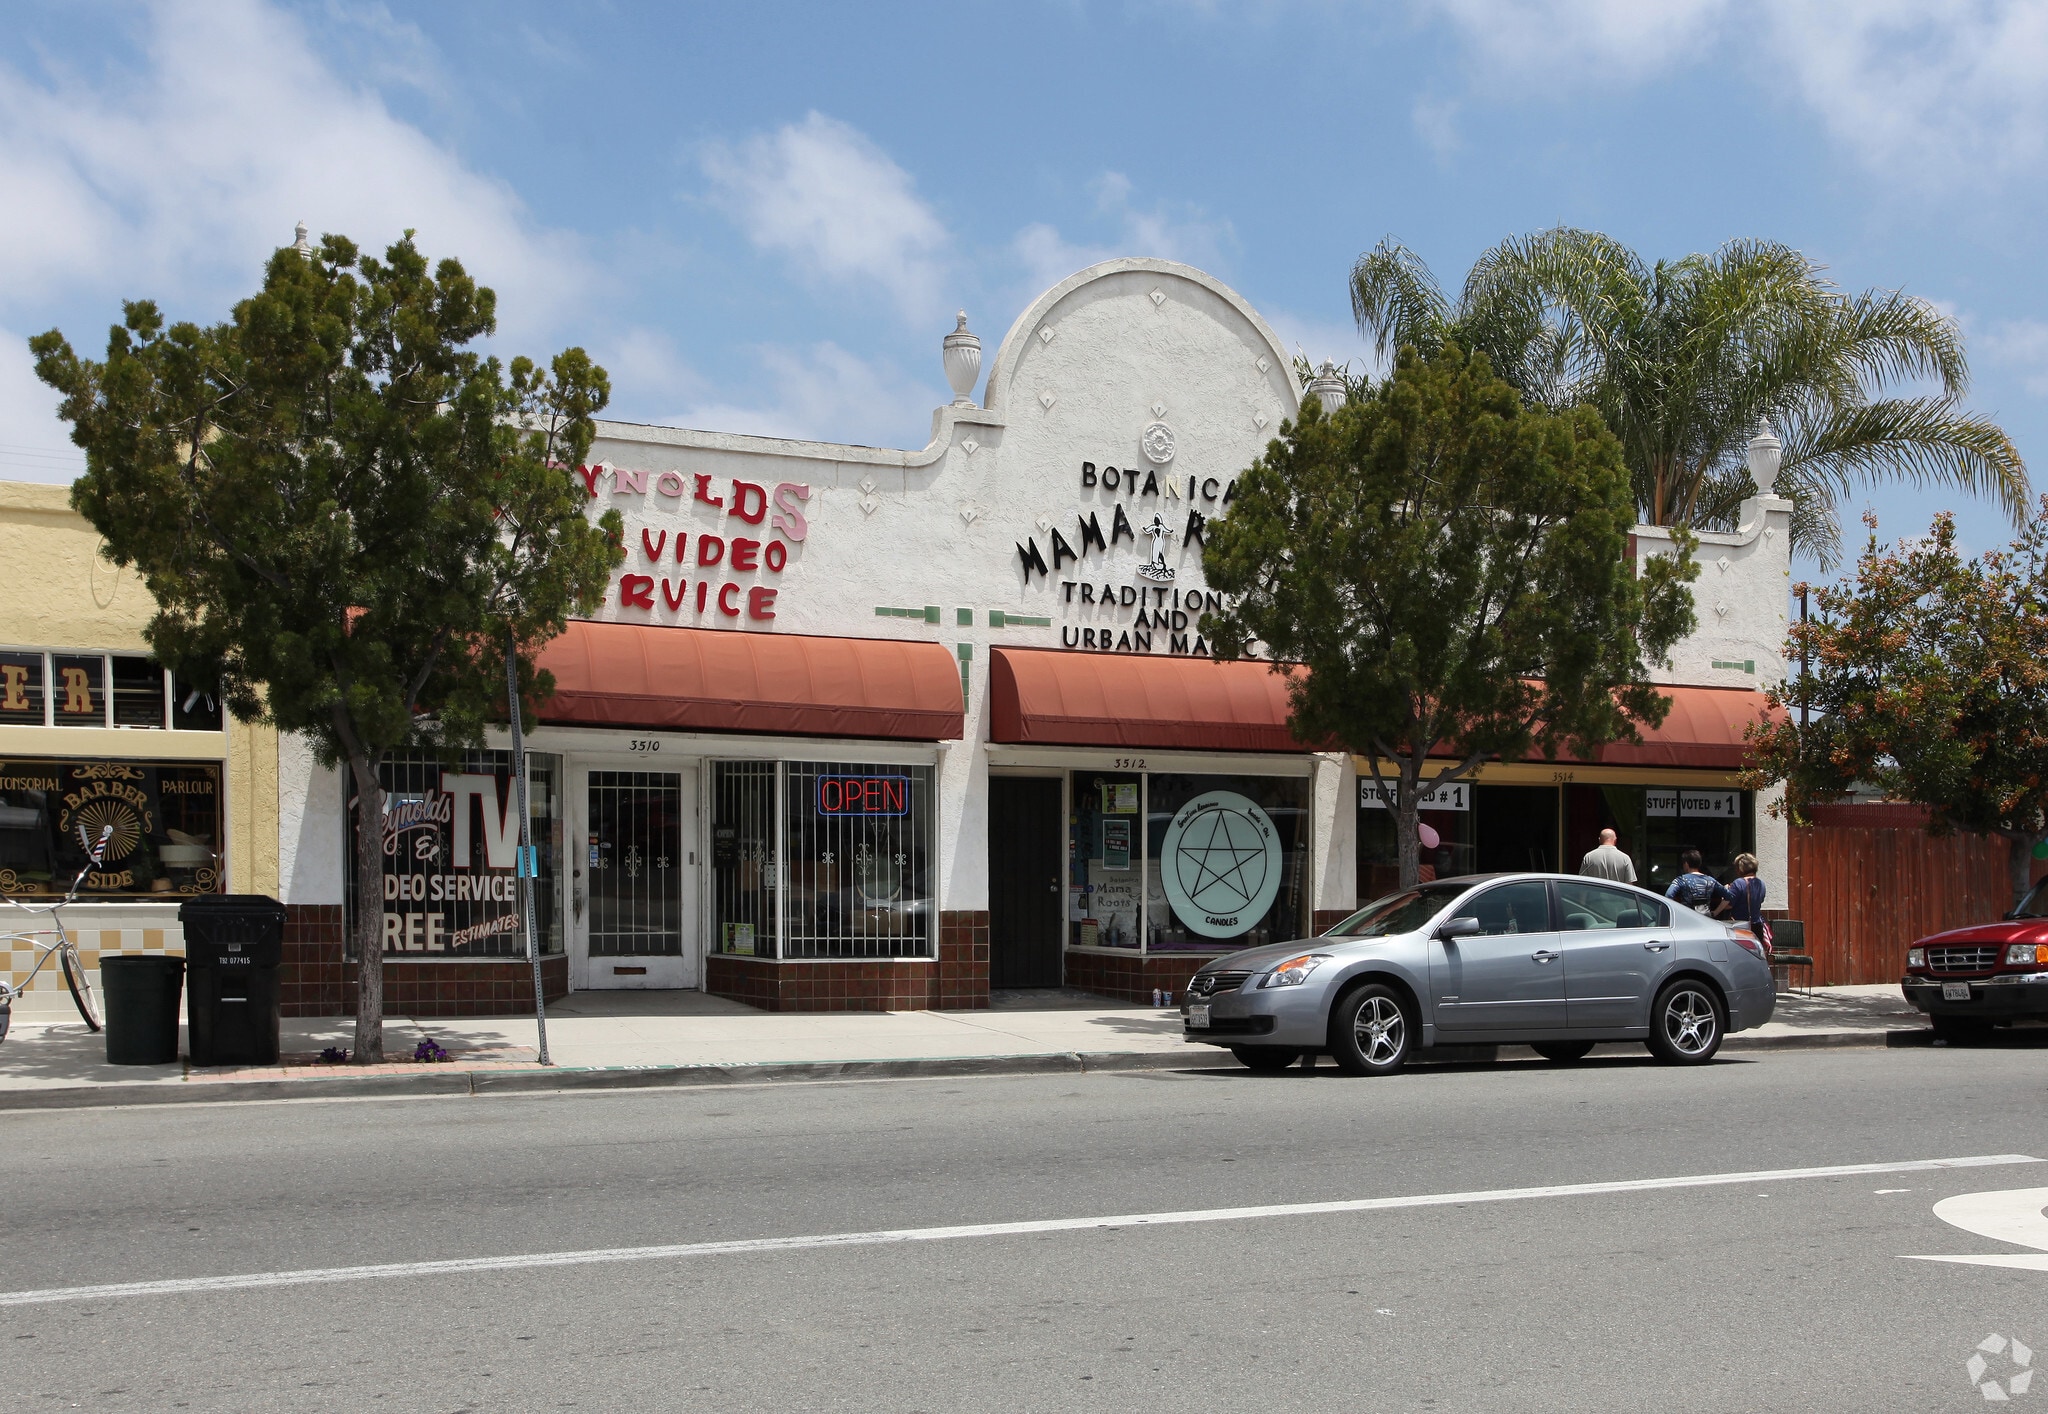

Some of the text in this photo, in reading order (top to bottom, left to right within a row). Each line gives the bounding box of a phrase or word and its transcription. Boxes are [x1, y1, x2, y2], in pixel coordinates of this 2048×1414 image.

[547, 460, 810, 542] YNOLDS
[642, 528, 787, 572] VIDEO
[1016, 503, 1135, 585] MAMA
[602, 573, 778, 620] RVICE
[1062, 581, 1240, 611] TRADITION
[1134, 608, 1188, 632] AND
[1062, 626, 1258, 658] URBAN MAC
[629, 740, 660, 751] 3510
[0, 777, 63, 791] TONSORIAL
[162, 780, 213, 794] PARLOUR
[1553, 772, 1574, 781] 3514
[64, 781, 148, 810] BARBER
[822, 780, 903, 811] OPEN
[1453, 787, 1464, 807] 1
[1647, 797, 1676, 809] STUFF
[1681, 799, 1710, 810] VOTED
[1726, 796, 1735, 815] 1
[347, 788, 451, 856] eynolds
[440, 772, 524, 869] TV
[88, 870, 134, 889] SIDE
[384, 874, 515, 901] DEO SERVICE
[1096, 883, 1132, 893] Mama
[382, 912, 520, 951] REE ESTIMATES
[1205, 916, 1239, 926] CANDLES
